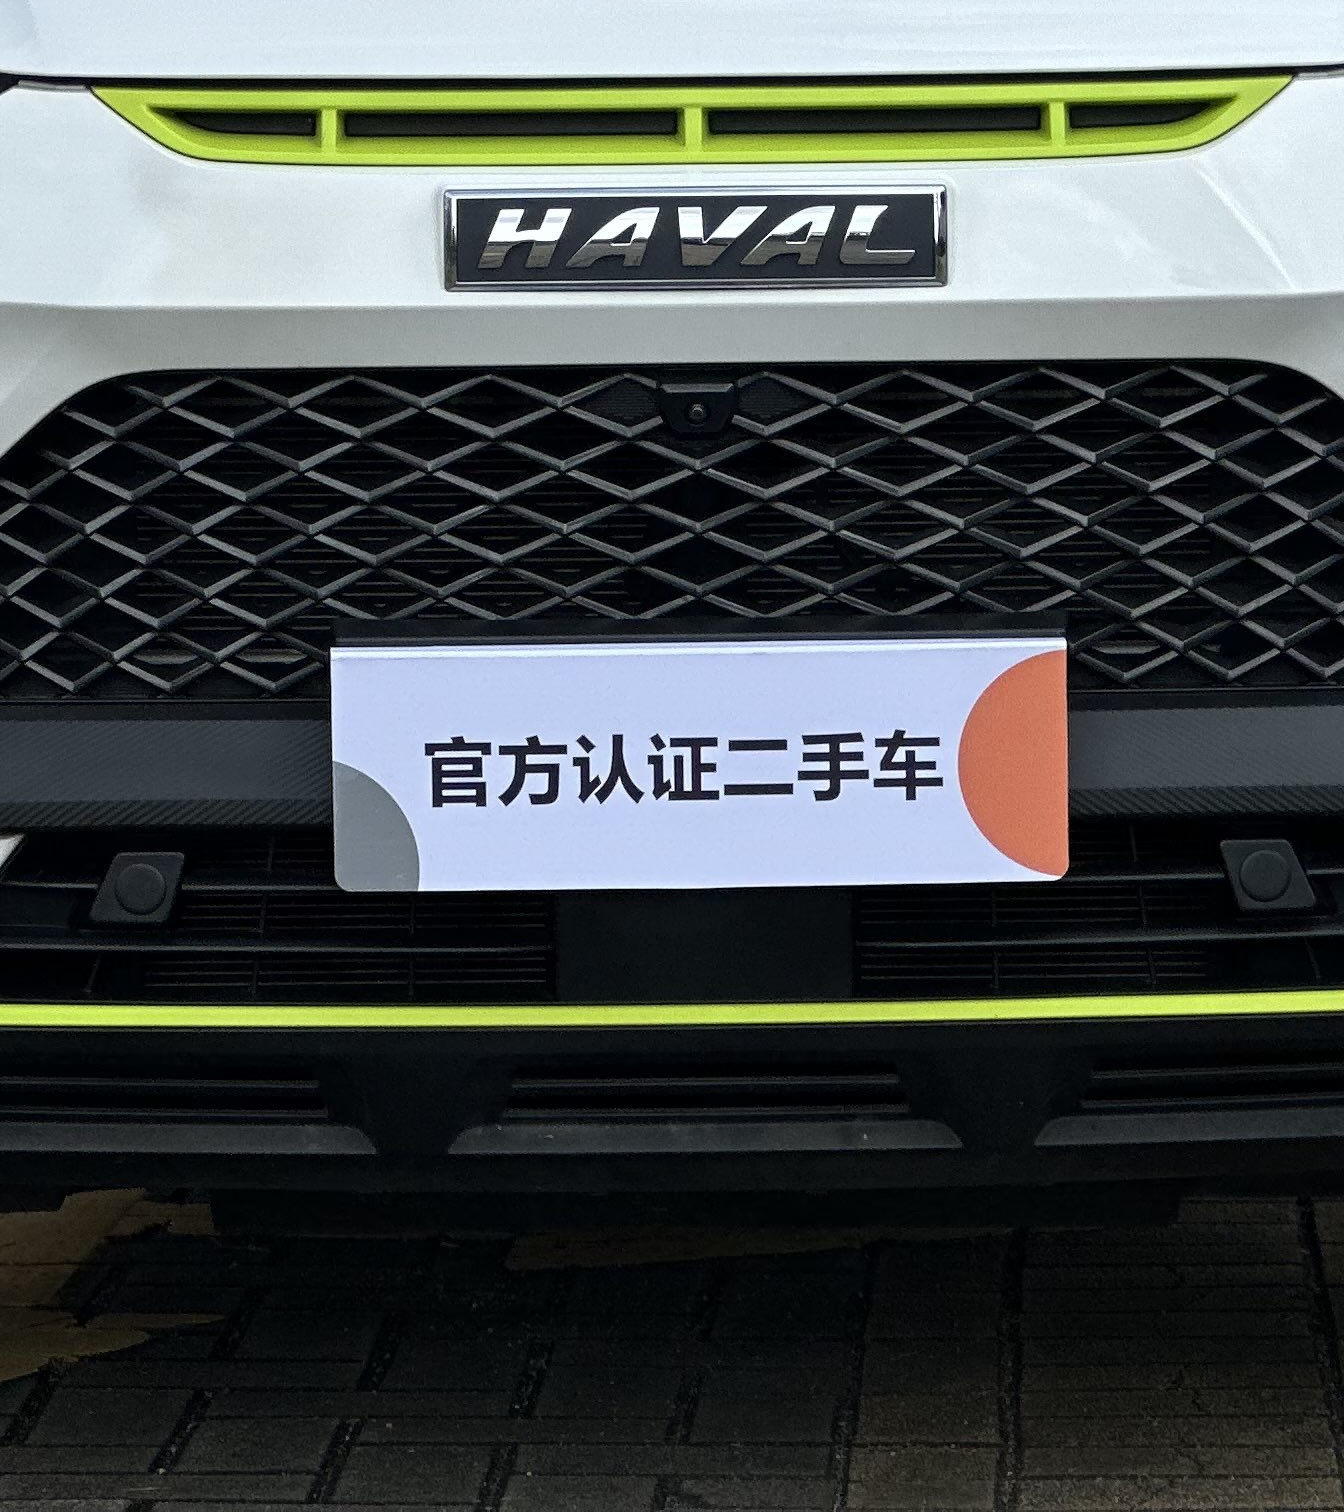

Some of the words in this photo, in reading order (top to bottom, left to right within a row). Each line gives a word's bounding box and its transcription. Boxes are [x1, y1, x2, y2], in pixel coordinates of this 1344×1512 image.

[476, 205, 916, 270] HAVAL
[424, 729, 943, 808] 官方认证二手车
